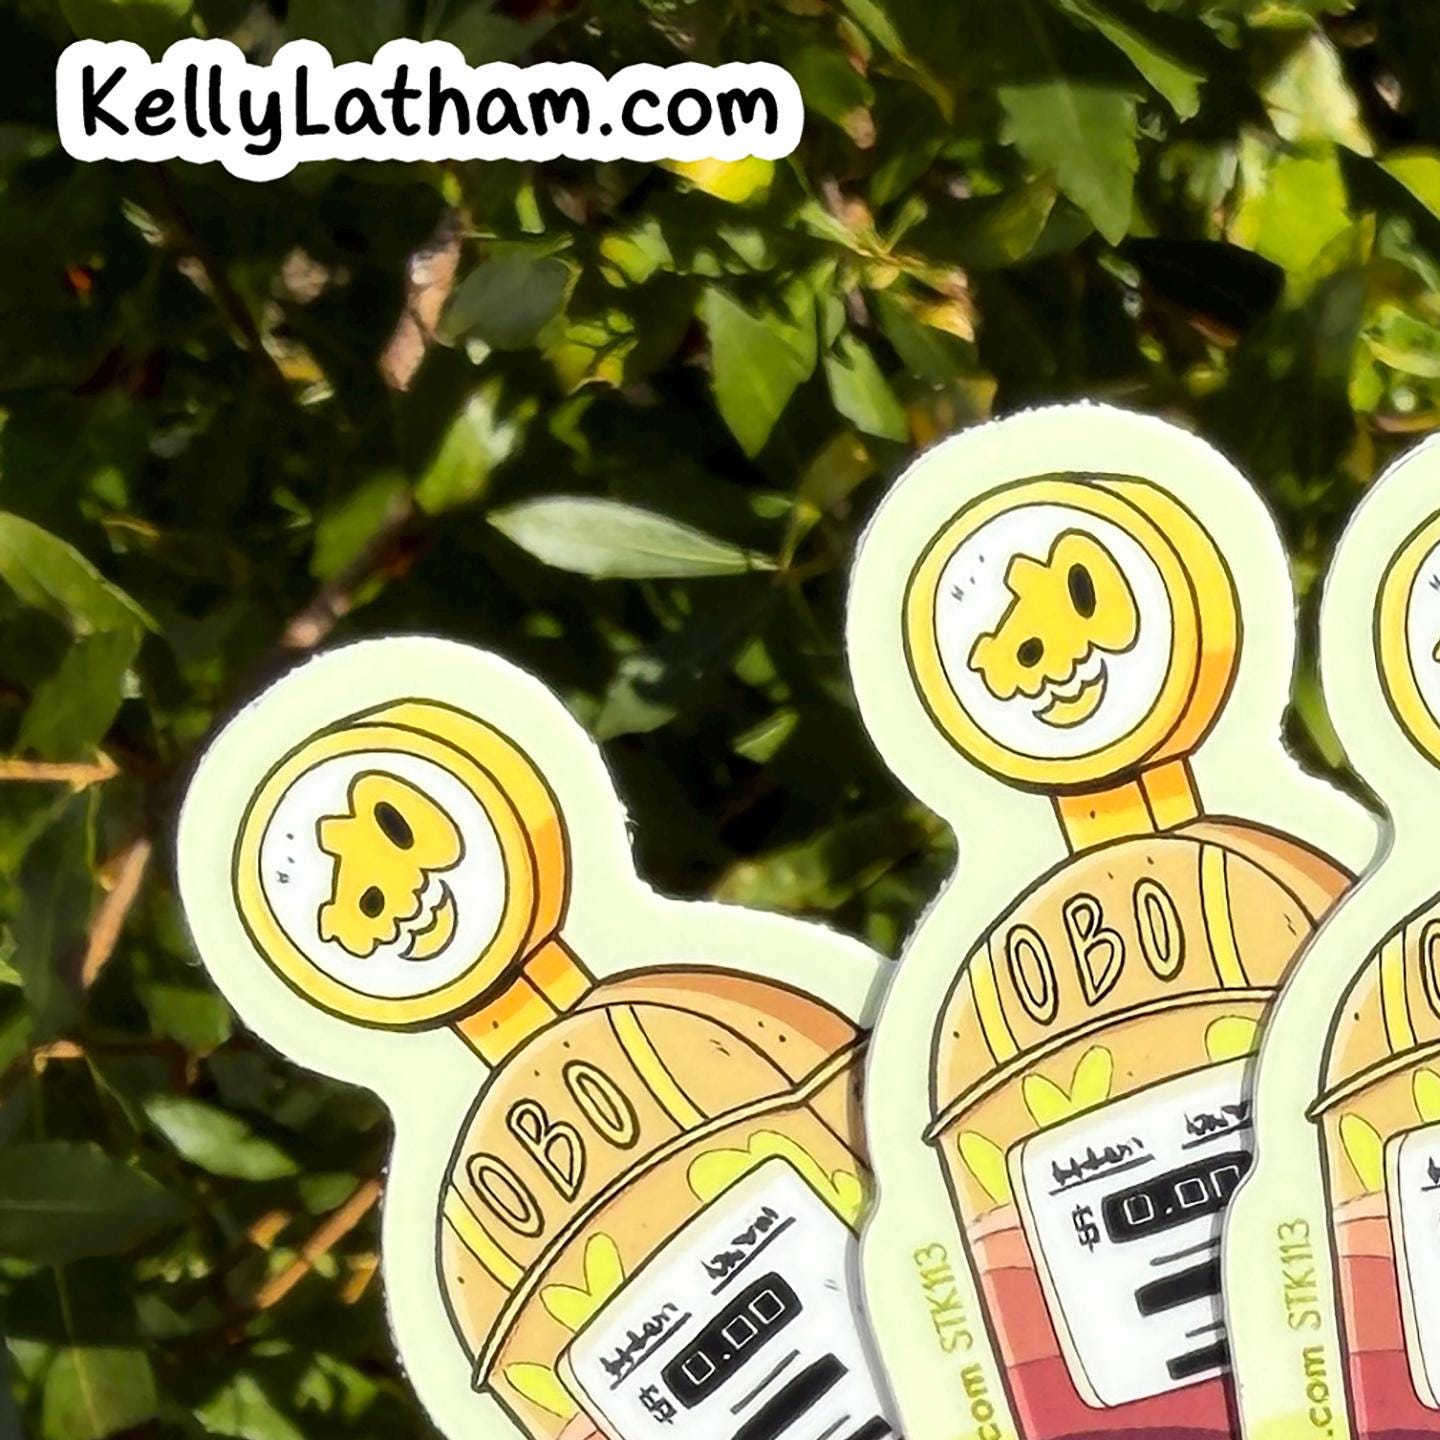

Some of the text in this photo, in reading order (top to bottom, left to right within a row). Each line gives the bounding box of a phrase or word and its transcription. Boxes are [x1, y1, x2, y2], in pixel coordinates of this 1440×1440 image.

[1006, 878, 1185, 1025] OBO
[466, 1060, 640, 1237] OBO
[912, 1241, 974, 1355] STK113
[1277, 1217, 1322, 1331] STK113
